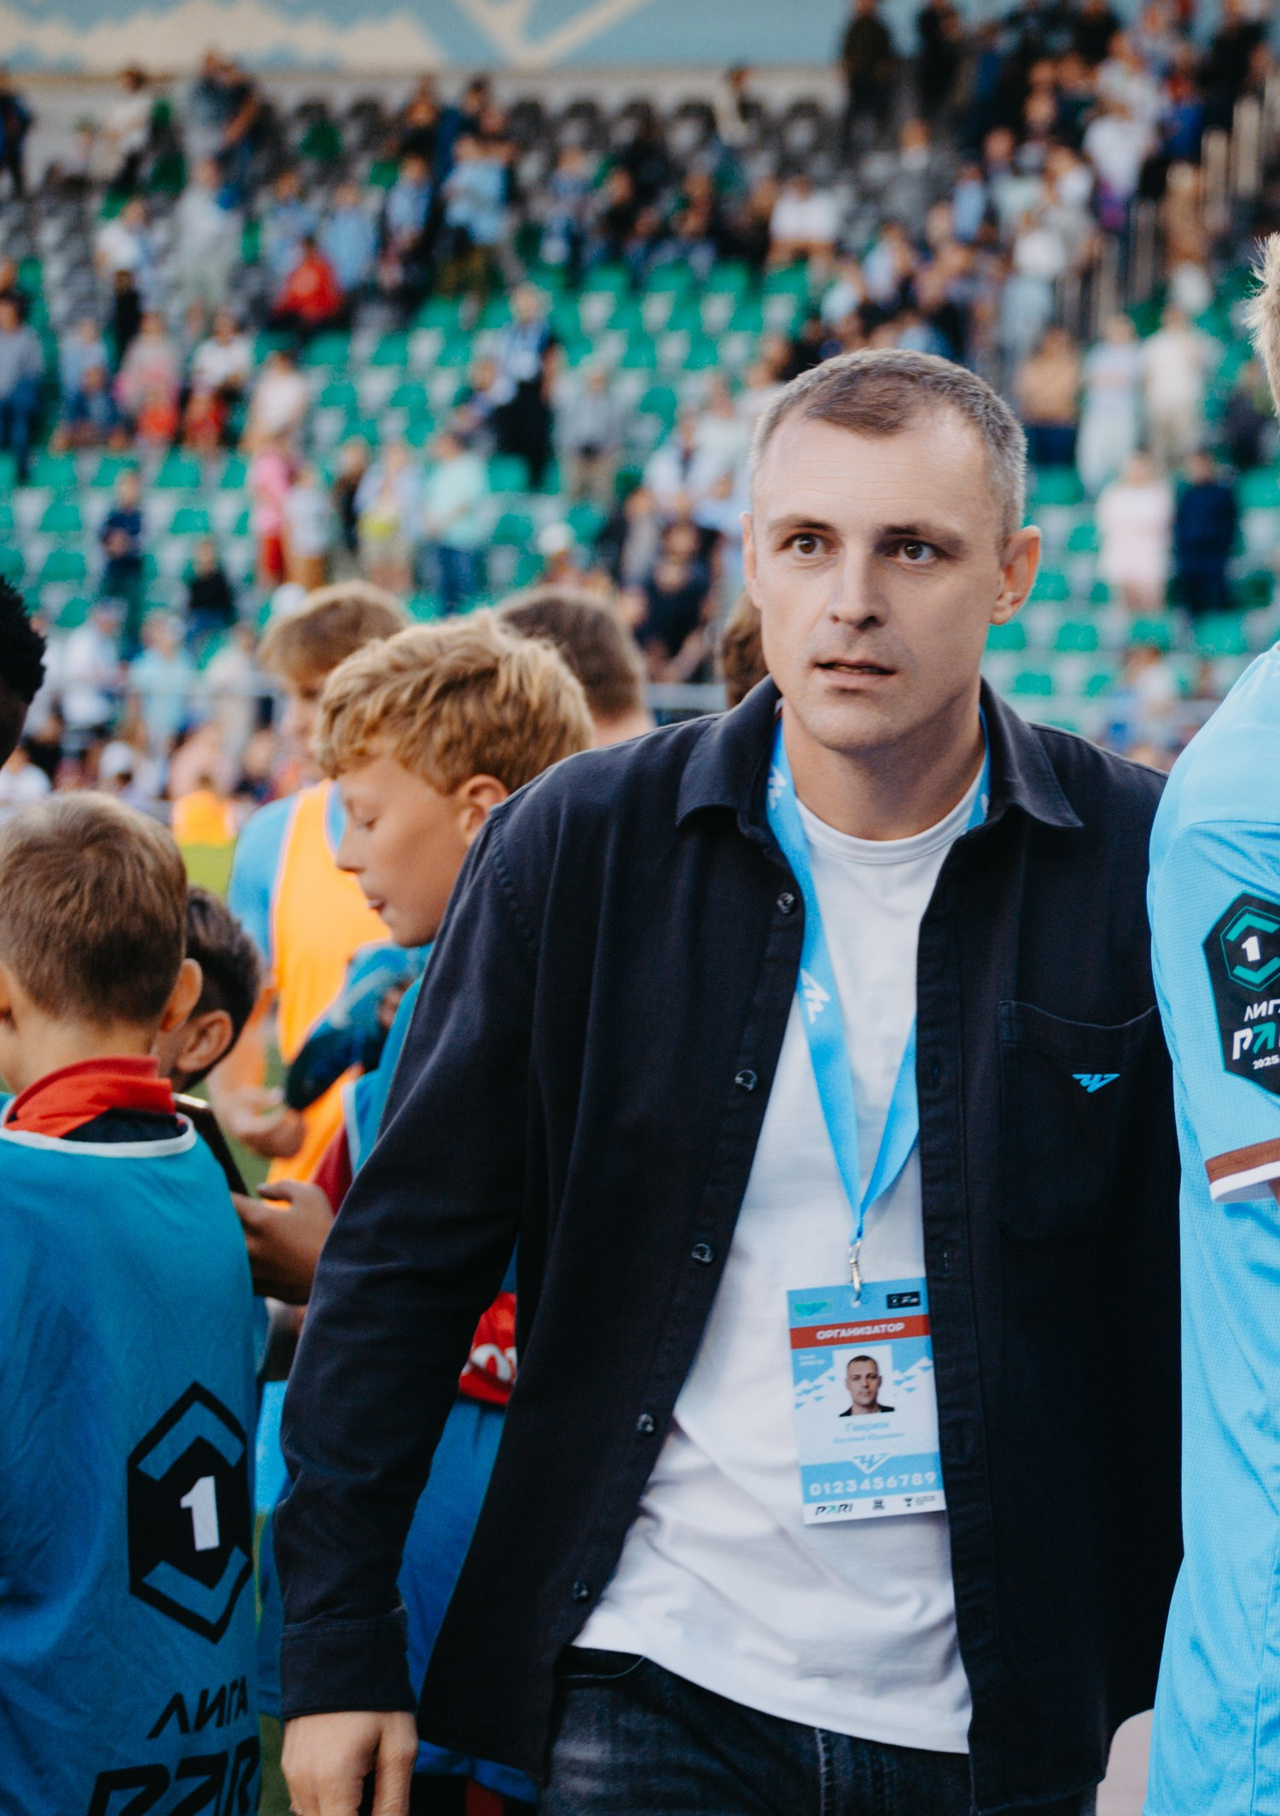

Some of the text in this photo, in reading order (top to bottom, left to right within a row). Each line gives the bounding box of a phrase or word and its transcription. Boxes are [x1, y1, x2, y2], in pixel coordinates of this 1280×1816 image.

[1241, 936, 1261, 962] 1
[816, 1322, 905, 1340] ОРГАНИЗАТОР
[808, 1471, 937, 1497] 0123456789
[180, 1475, 219, 1551] 1
[815, 1503, 853, 1516] PARI
[147, 1675, 248, 1739] ЛИГА
